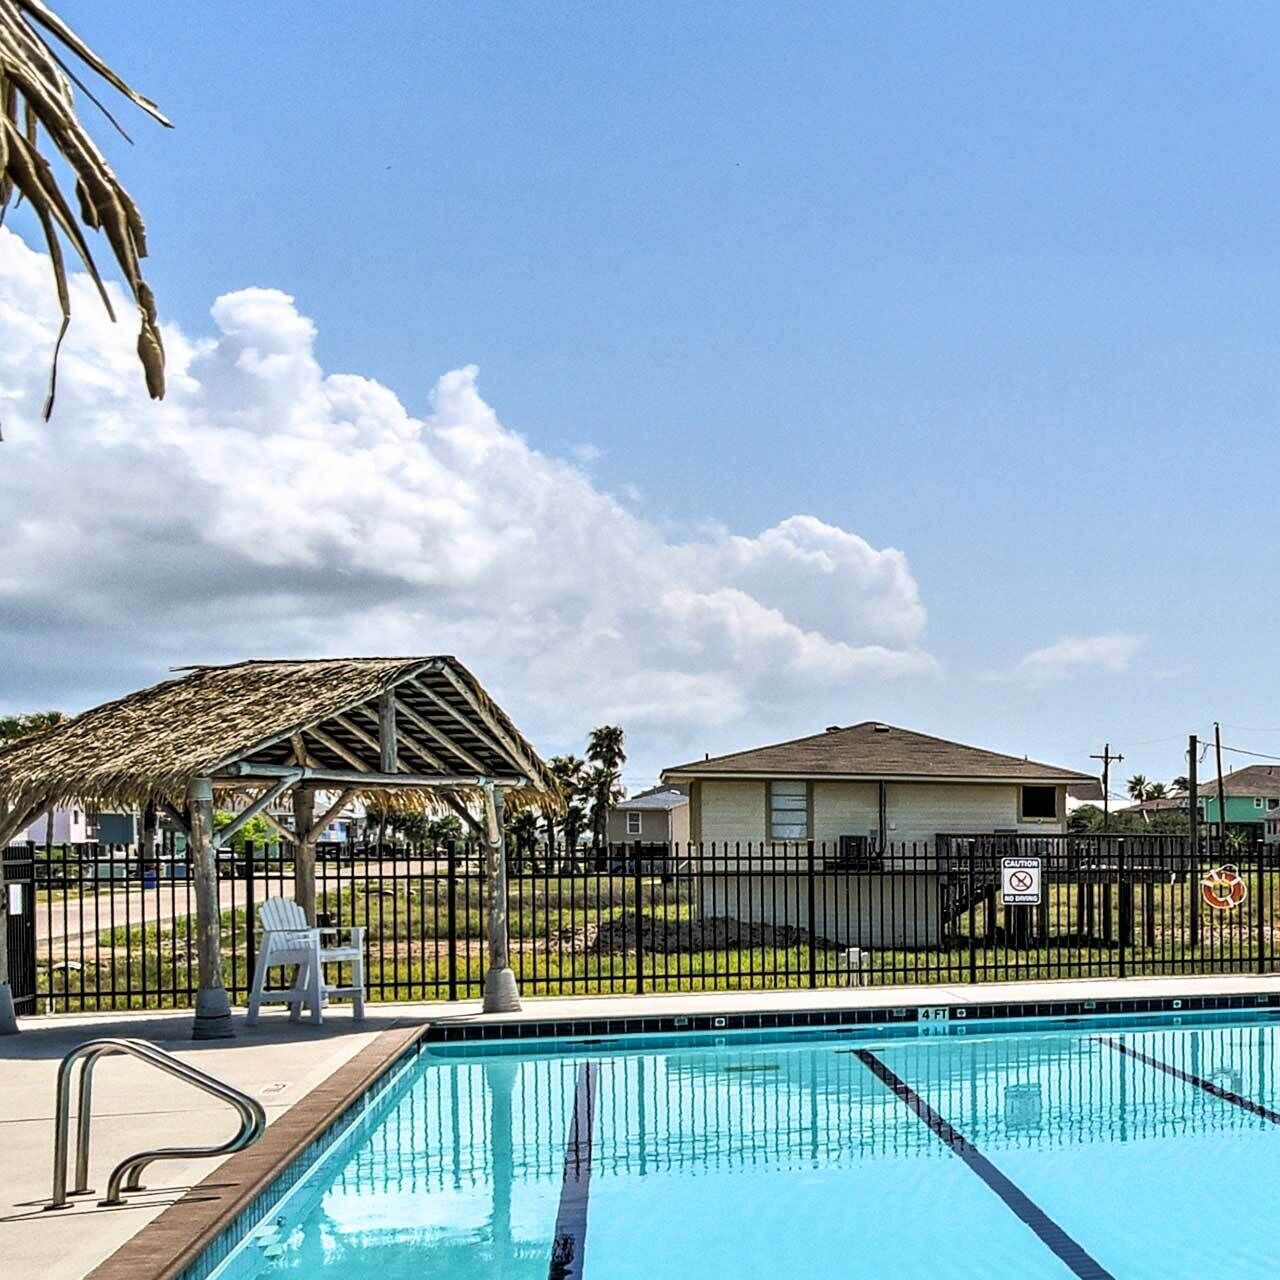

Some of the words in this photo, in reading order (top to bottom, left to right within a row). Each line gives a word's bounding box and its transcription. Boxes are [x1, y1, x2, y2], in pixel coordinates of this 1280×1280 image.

[1004, 860, 1038, 868] CAUTION
[922, 1009, 930, 1020] 4
[934, 1008, 947, 1019] FT
